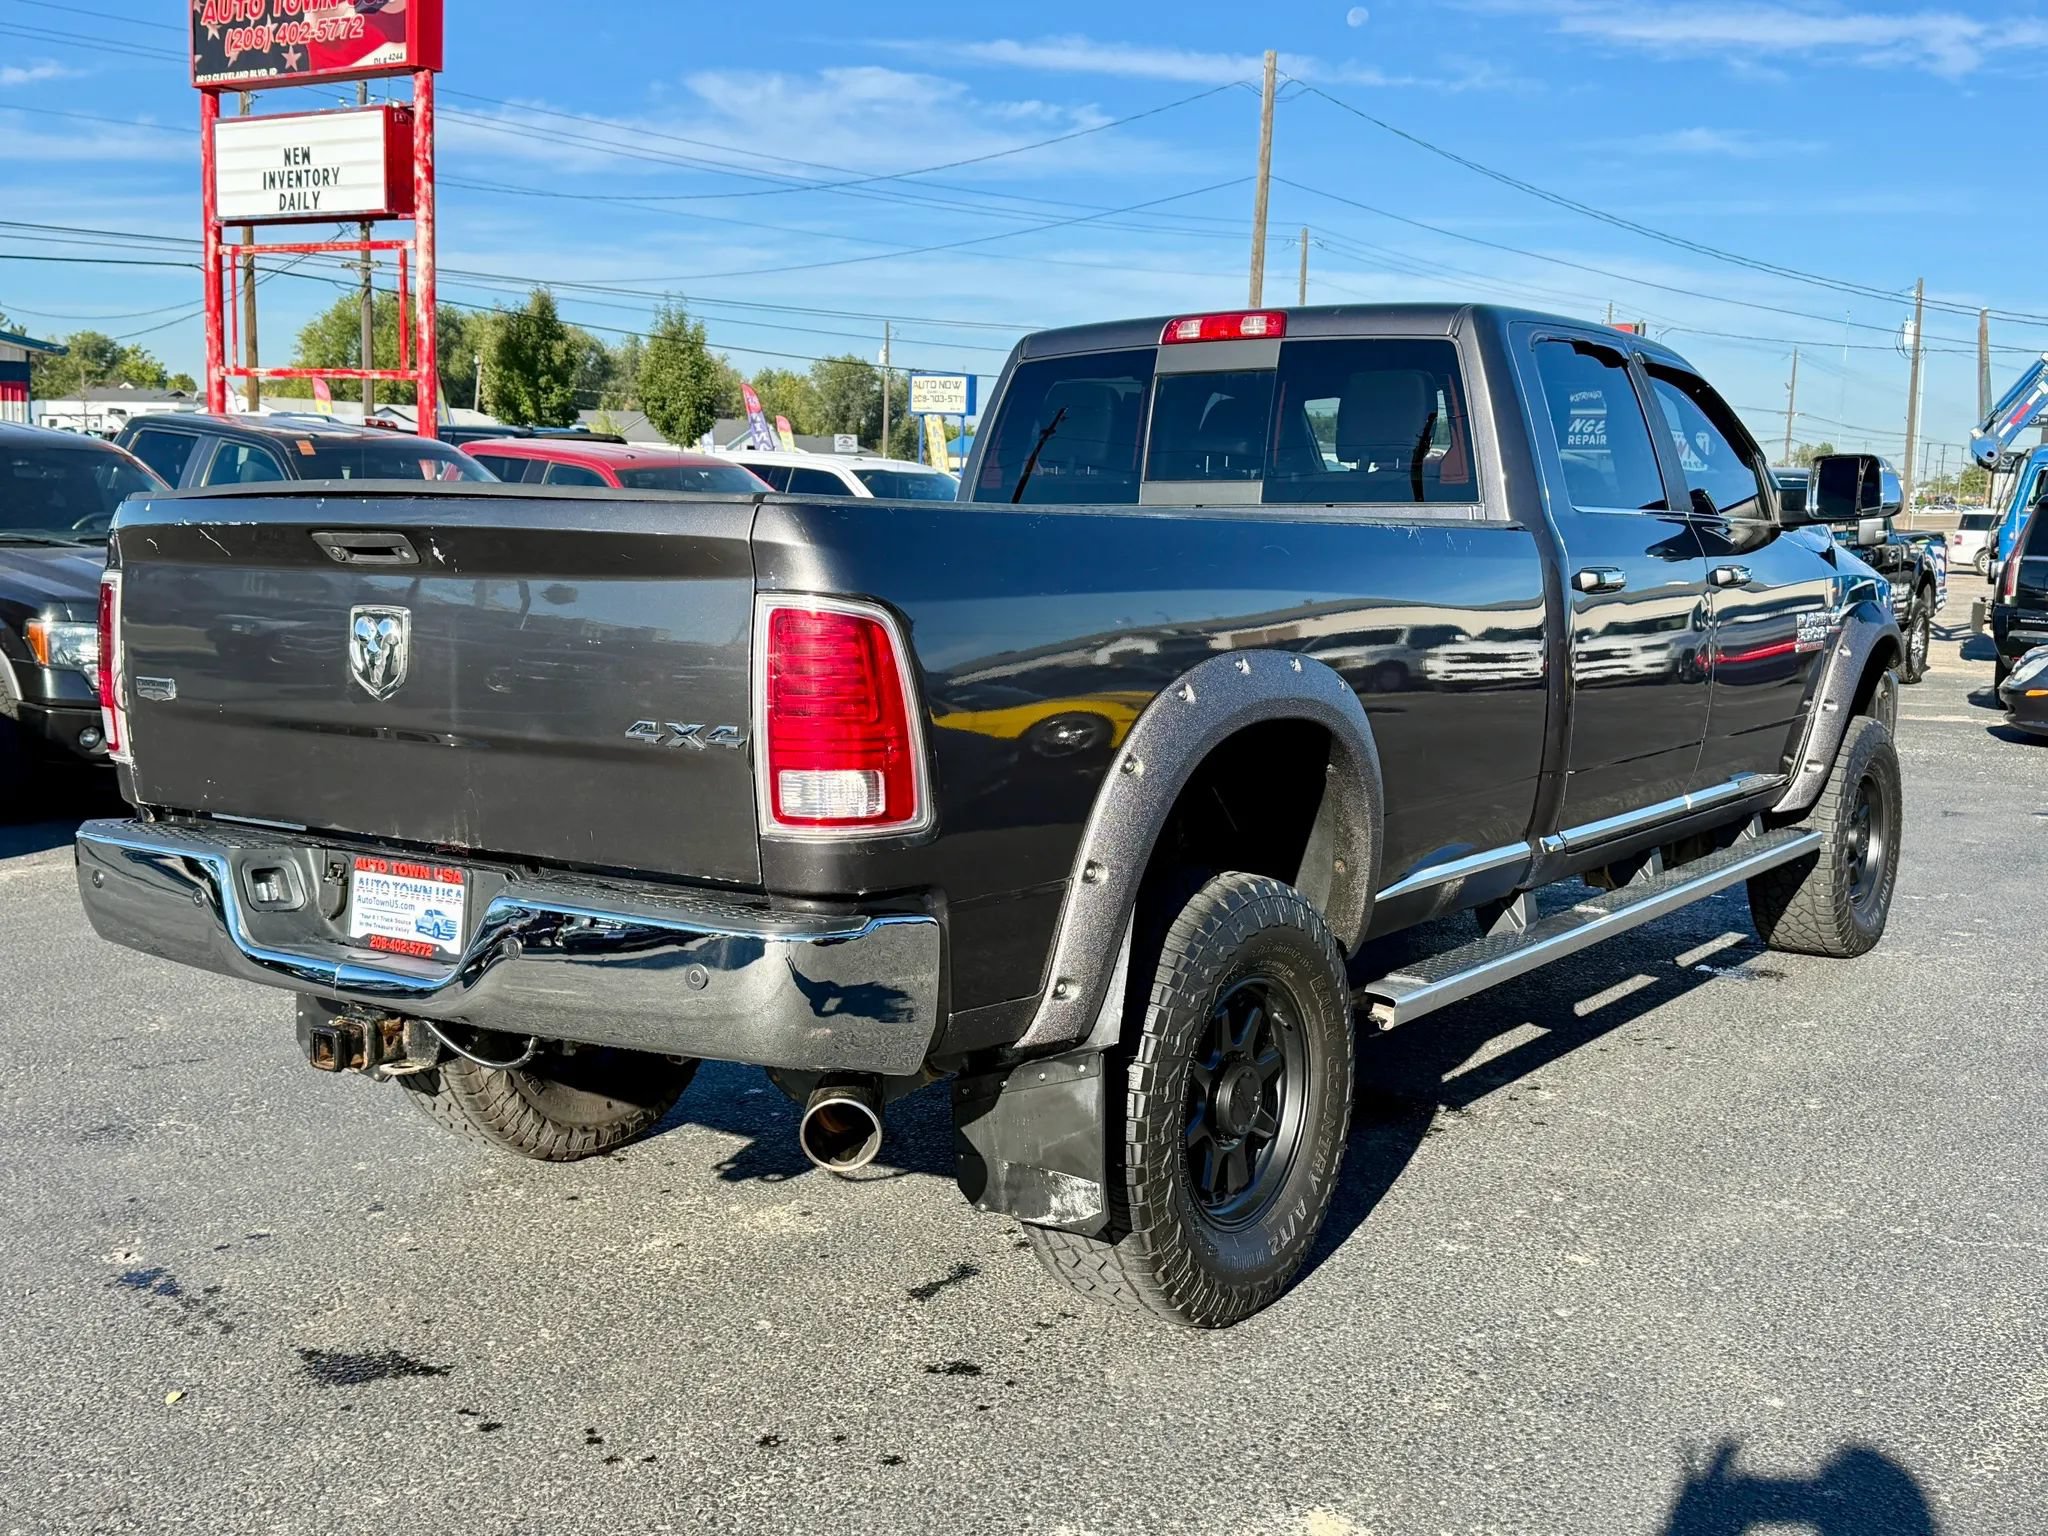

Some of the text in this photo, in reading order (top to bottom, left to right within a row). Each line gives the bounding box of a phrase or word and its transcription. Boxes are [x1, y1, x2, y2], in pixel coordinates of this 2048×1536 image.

[200, 0, 266, 26] AUTO
[224, 13, 365, 57] (208) 402-5772
[212, 70, 249, 82] CLEVELAND
[284, 146, 311, 167] NEW
[263, 167, 340, 190] INVENTORY
[279, 191, 320, 211] DAILY
[913, 380, 962, 390] AUTO NOW
[1567, 434, 1607, 445] REPAIR
[354, 857, 465, 884] AUTO TOWN USA
[357, 895, 416, 911] AutoTownUS.com
[369, 935, 434, 957] 208-402-5772
[1310, 974, 1338, 1041] BACK
[1308, 1056, 1340, 1196] COUNTRY
